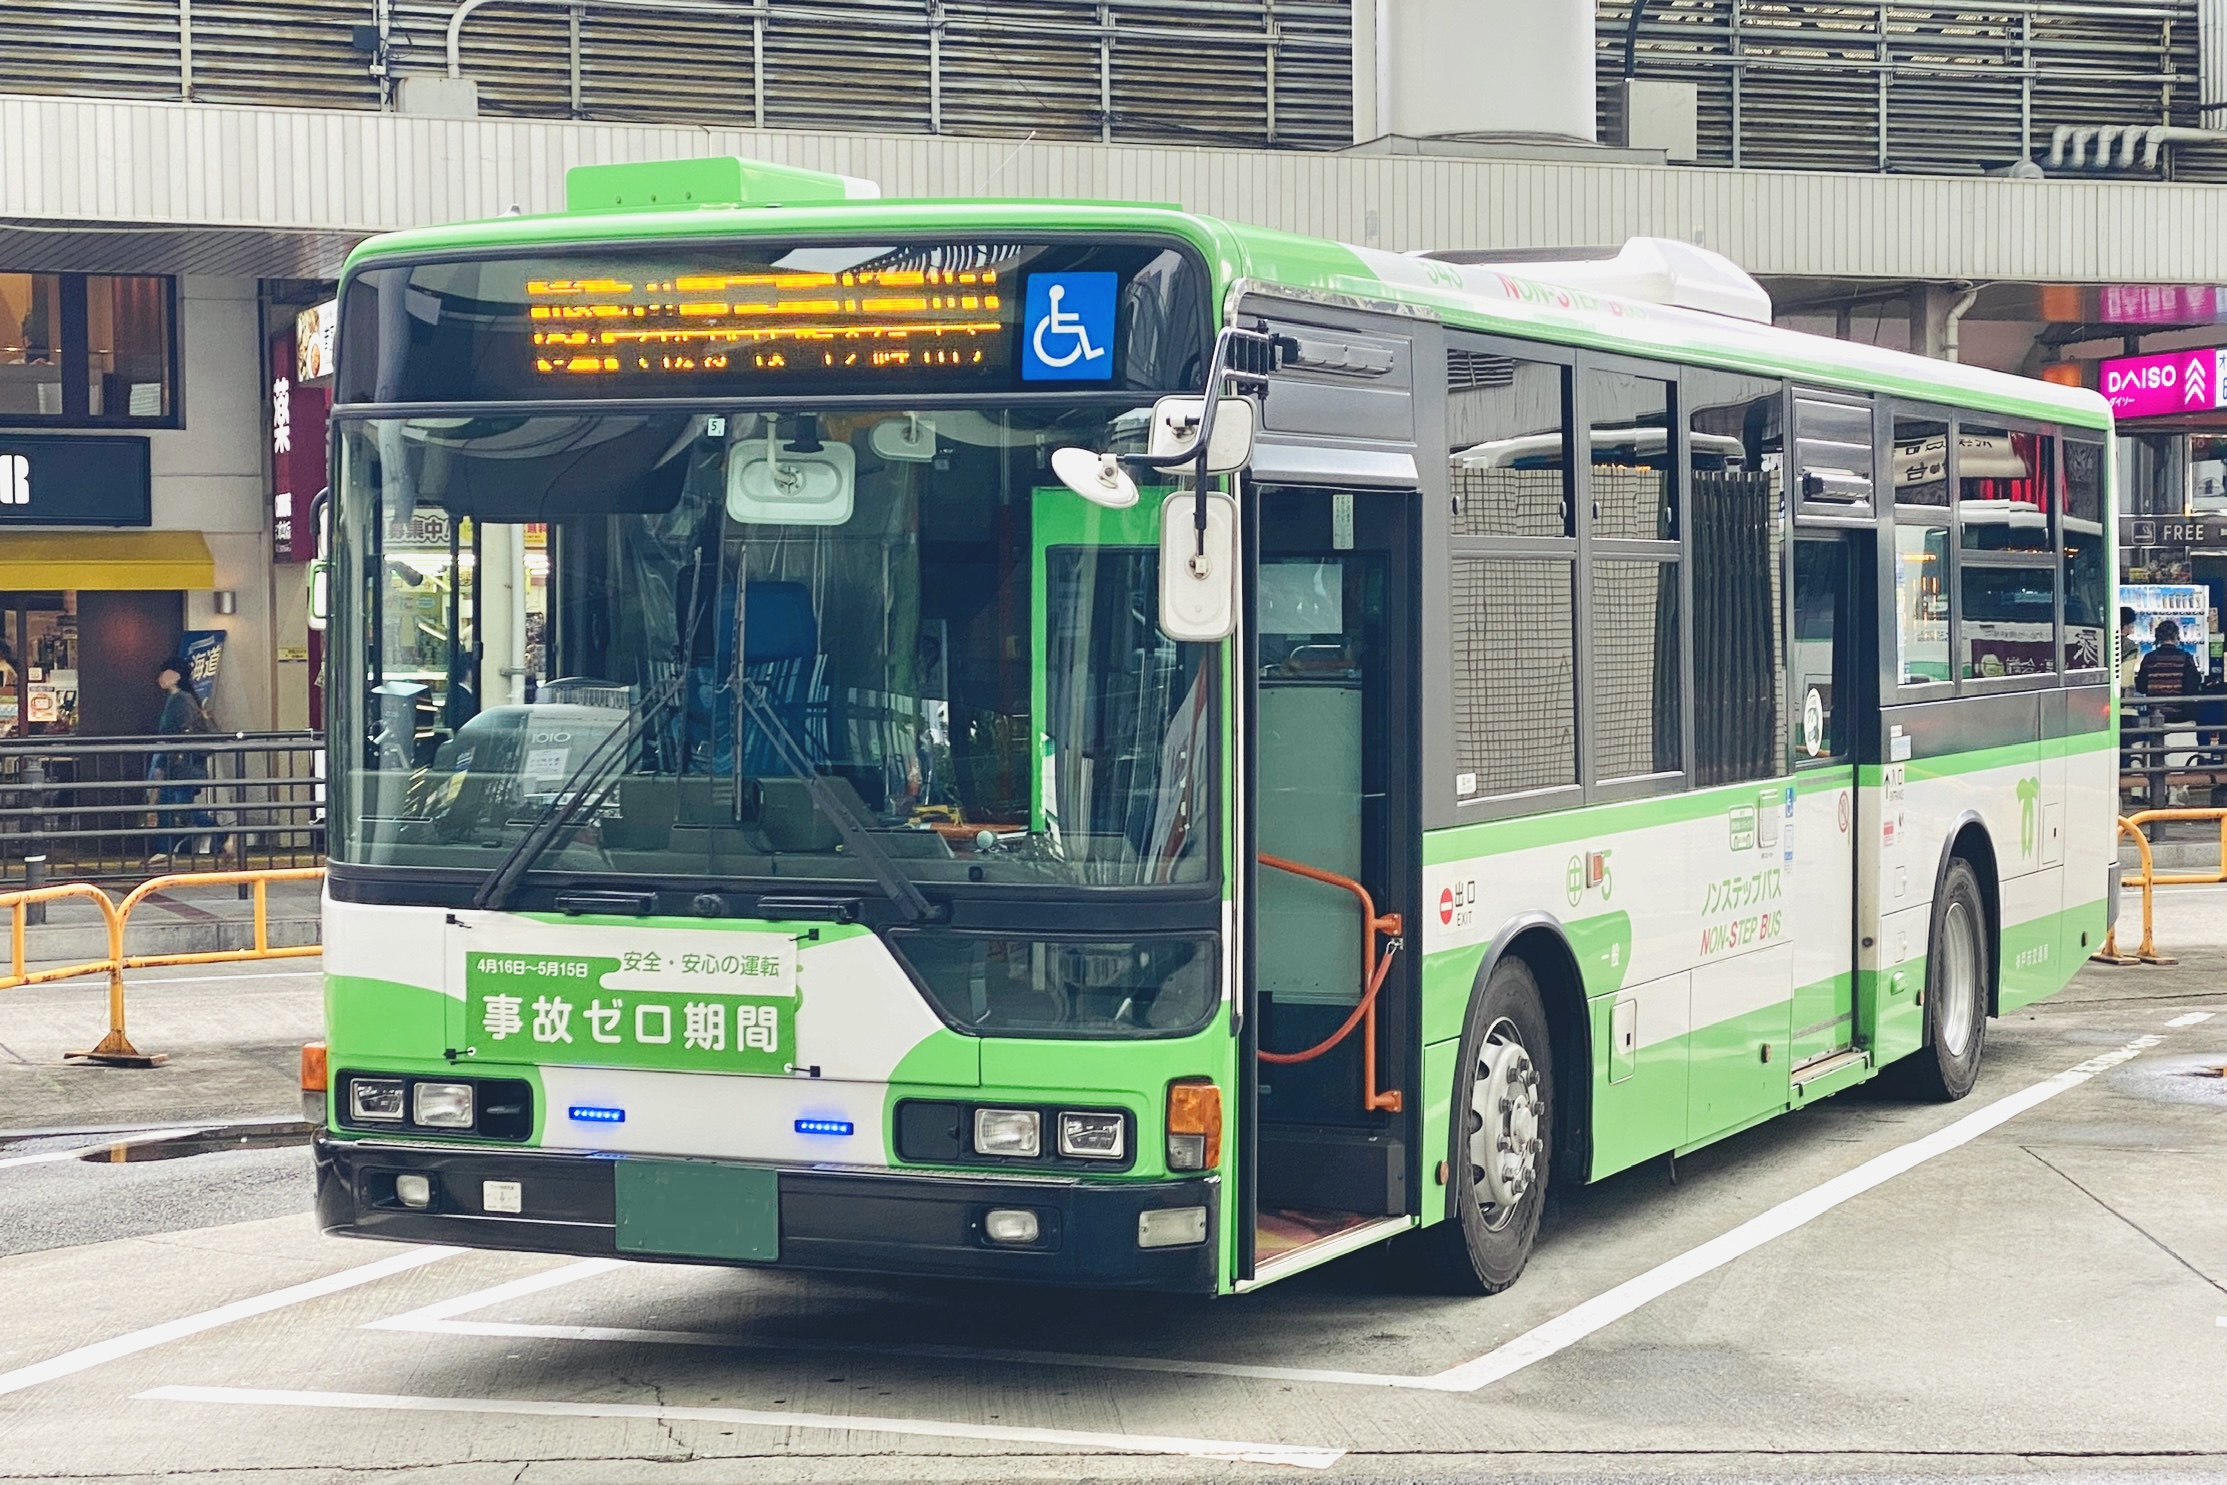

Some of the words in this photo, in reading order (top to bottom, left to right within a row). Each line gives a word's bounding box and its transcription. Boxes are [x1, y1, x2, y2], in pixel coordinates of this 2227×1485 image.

[2107, 364, 2177, 393] DAISO
[2163, 524, 2205, 541] FREE
[1455, 880, 1476, 908] 出口
[1701, 868, 1782, 918] ノンステップバス
[1457, 910, 1473, 927] EXIT
[1700, 916, 1759, 957] NON-STEP
[1760, 909, 1783, 941] BUS
[623, 950, 780, 978] 安全・安心の運転
[481, 992, 778, 1054] 事故ゼロ期間
